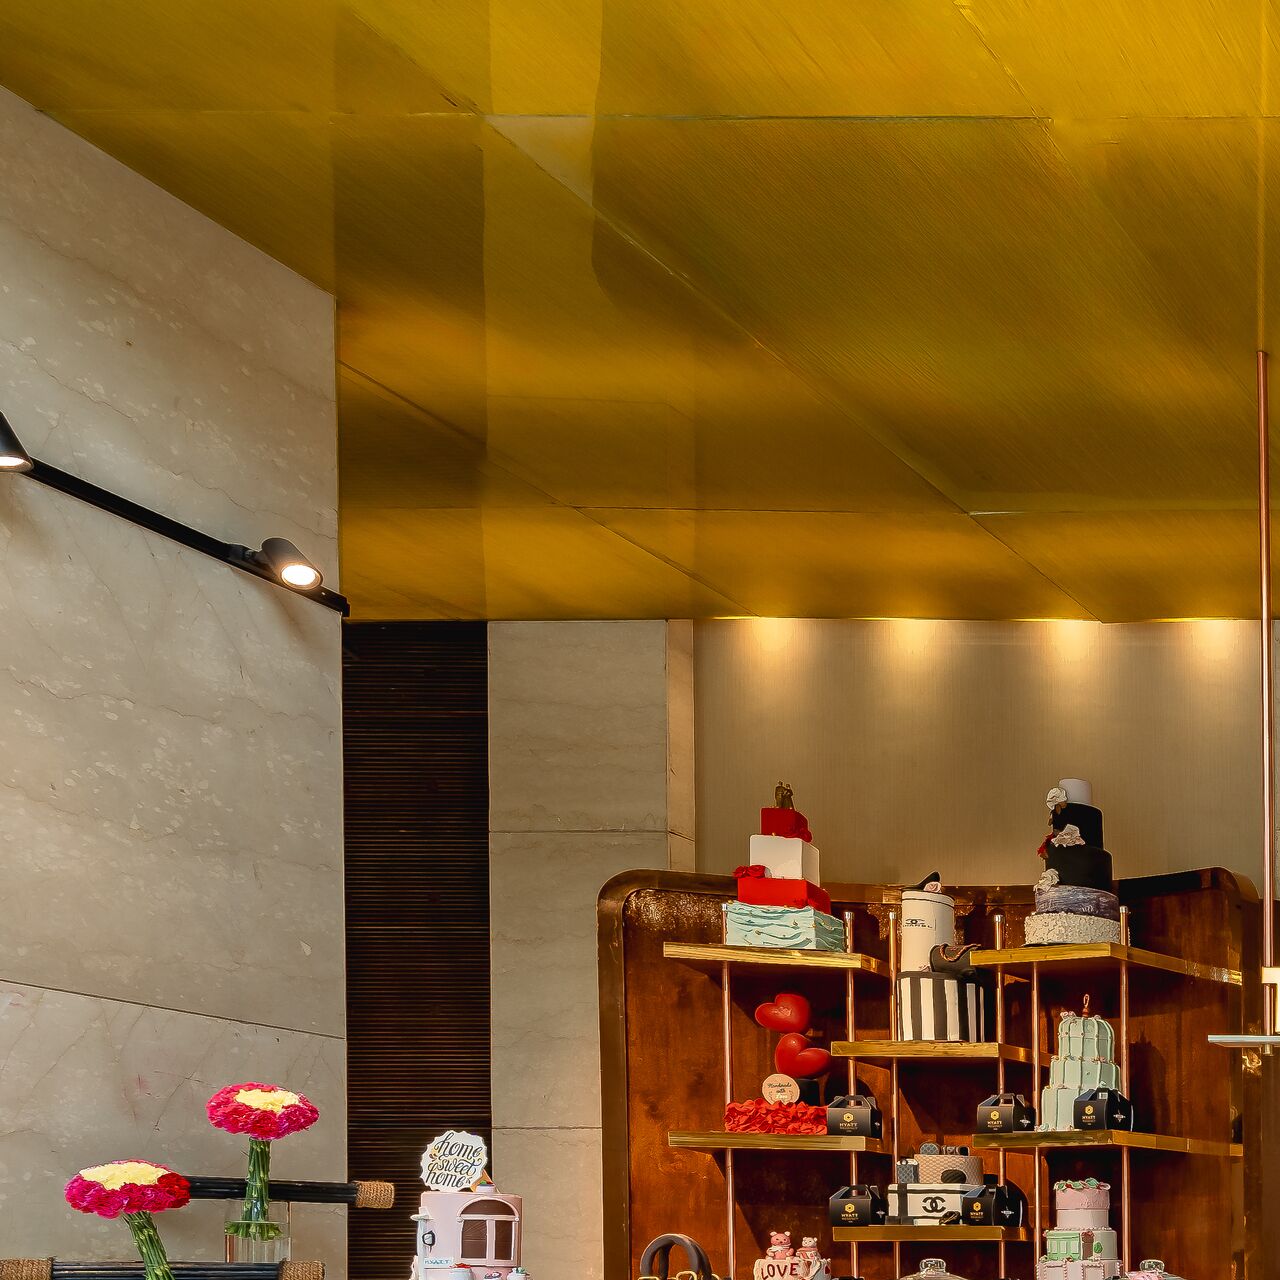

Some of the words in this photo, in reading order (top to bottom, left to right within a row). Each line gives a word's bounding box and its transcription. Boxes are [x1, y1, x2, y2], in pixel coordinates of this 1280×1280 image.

[434, 1132, 483, 1159] home
[426, 1162, 467, 1188] home
[437, 1157, 482, 1176] sweet
[761, 1263, 799, 1280] LOVE
